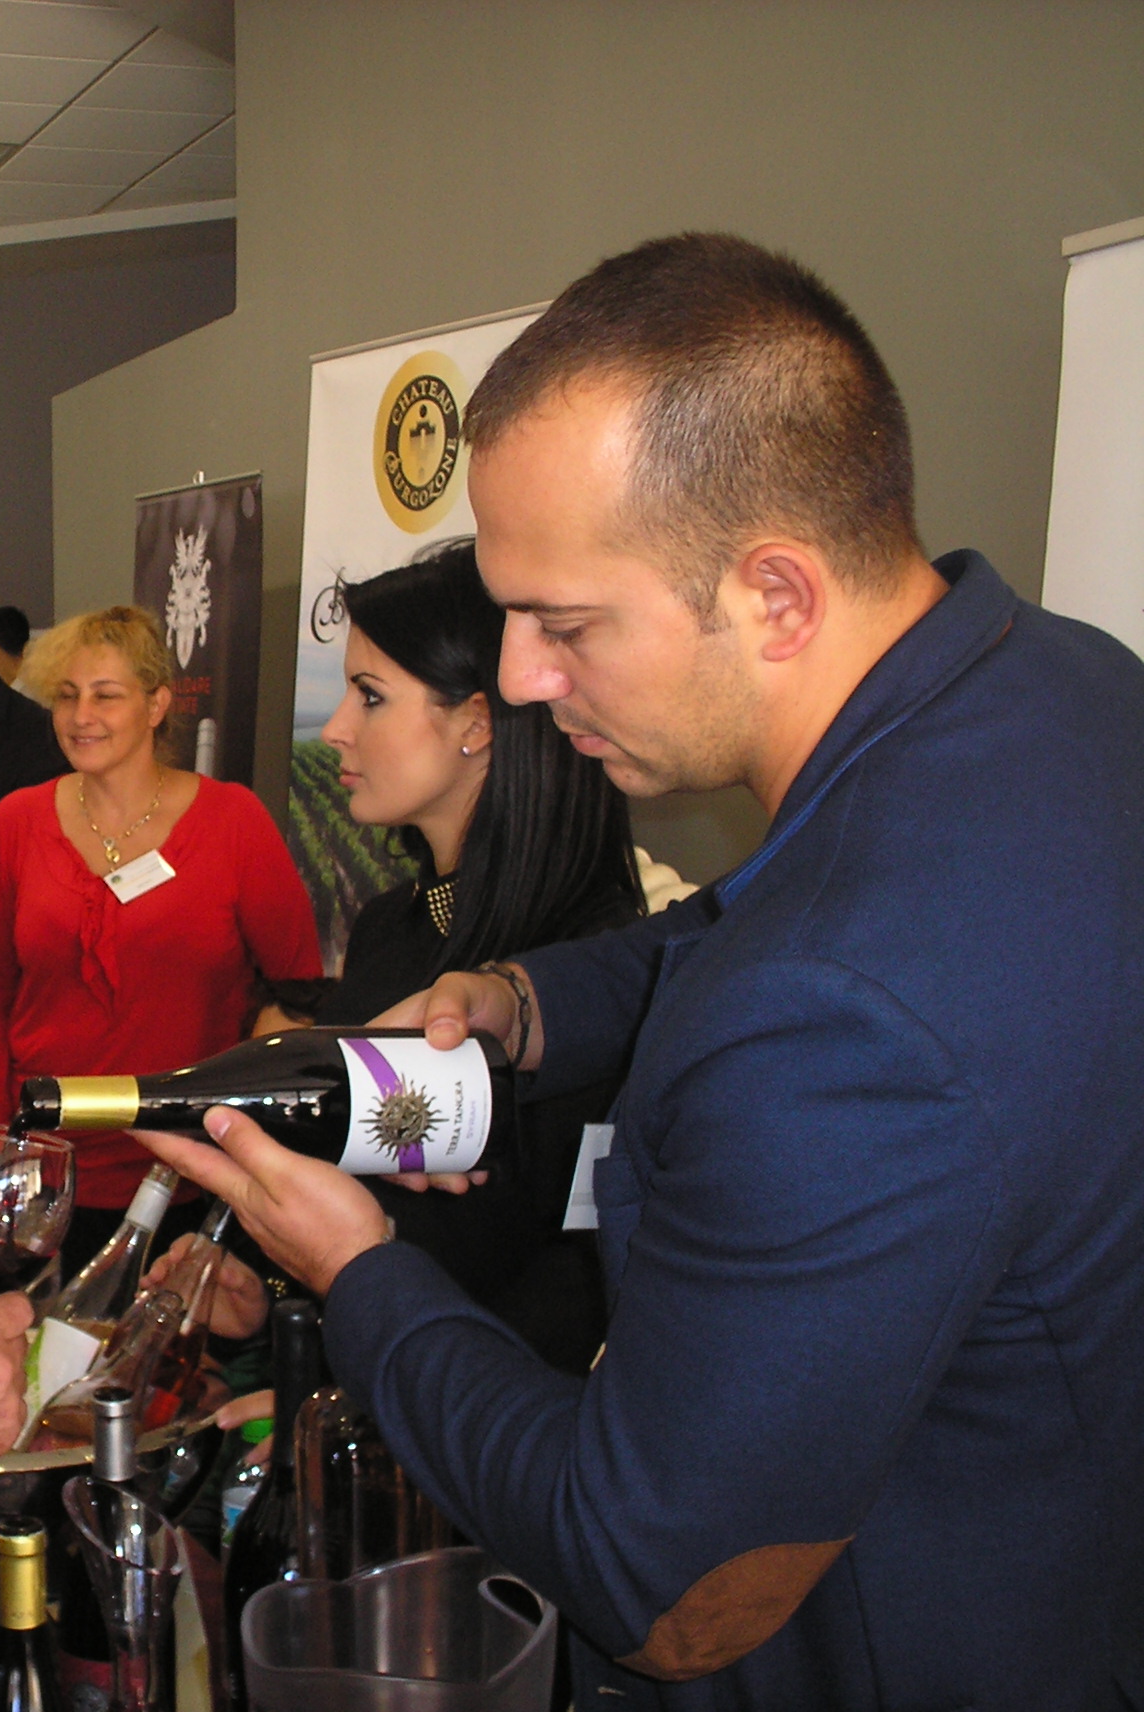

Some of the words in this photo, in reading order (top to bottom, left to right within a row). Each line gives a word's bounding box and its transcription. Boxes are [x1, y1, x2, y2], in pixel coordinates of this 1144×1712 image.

[391, 379, 455, 426] CHATEAU
[384, 438, 458, 507] BURGOZONE
[445, 1127, 461, 1155] TERRA
